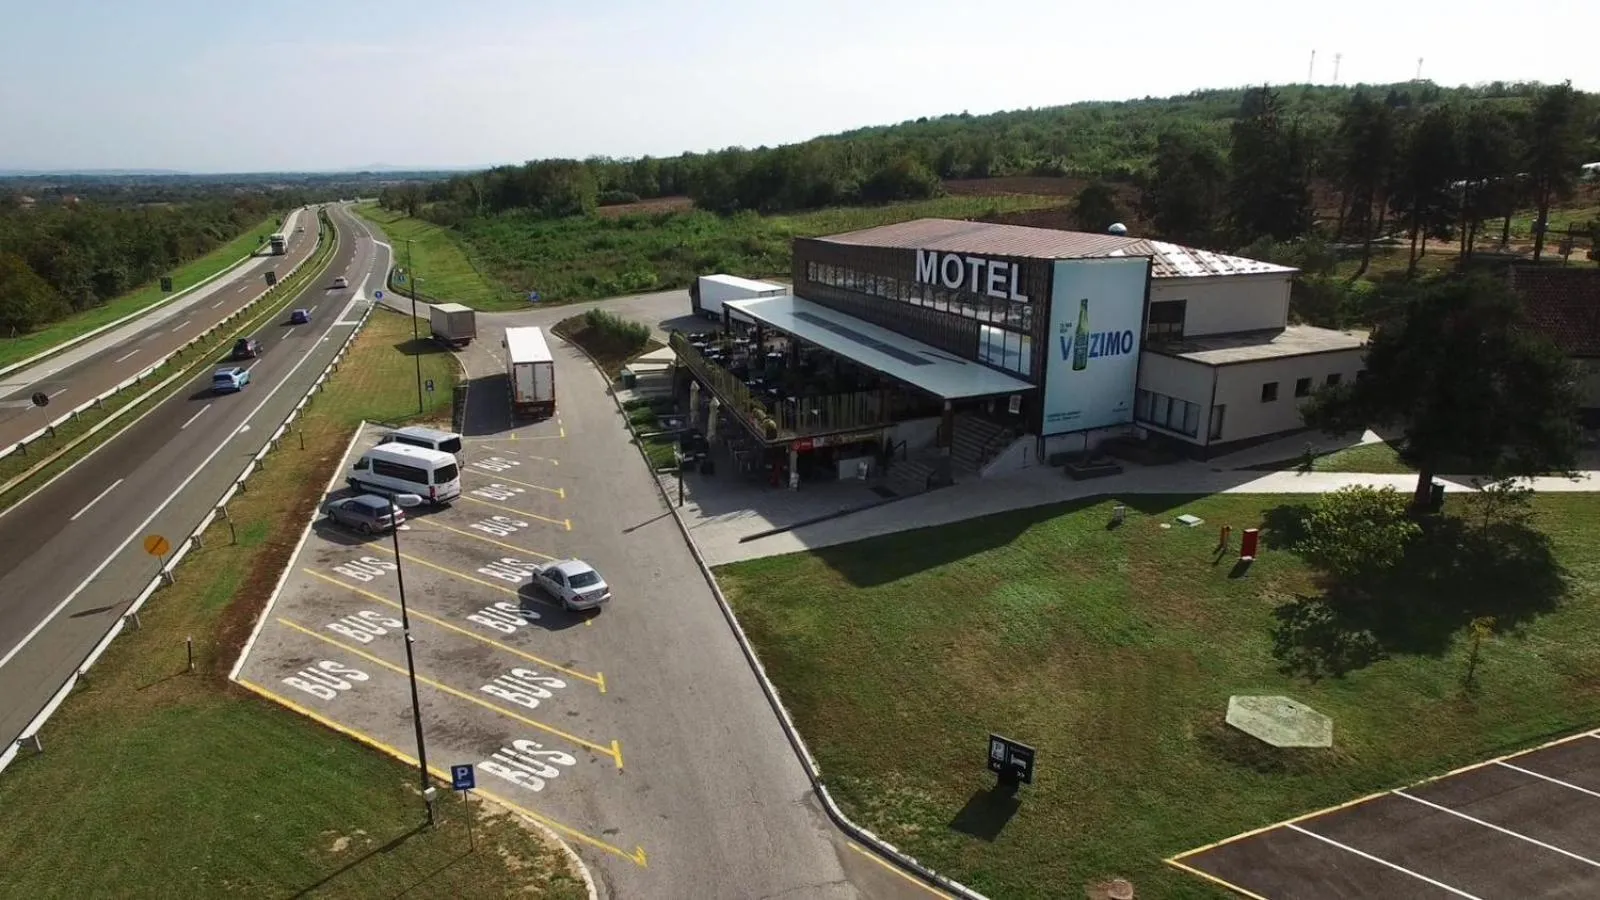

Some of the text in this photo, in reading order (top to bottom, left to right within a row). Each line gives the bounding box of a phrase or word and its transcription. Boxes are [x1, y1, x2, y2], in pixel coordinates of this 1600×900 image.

[916, 249, 1028, 302] MOTEL
[1060, 330, 1133, 361] VZIMO
[472, 457, 520, 471] BUS
[470, 484, 525, 500] BUS
[469, 516, 528, 536] BUS
[332, 556, 398, 582] BUS
[477, 558, 540, 583] BUS
[325, 610, 404, 643] BUS
[466, 602, 541, 634] BUS
[281, 660, 369, 700] BUS
[480, 668, 567, 709] BUS
[457, 767, 469, 780] P
[477, 739, 577, 792] BUS
